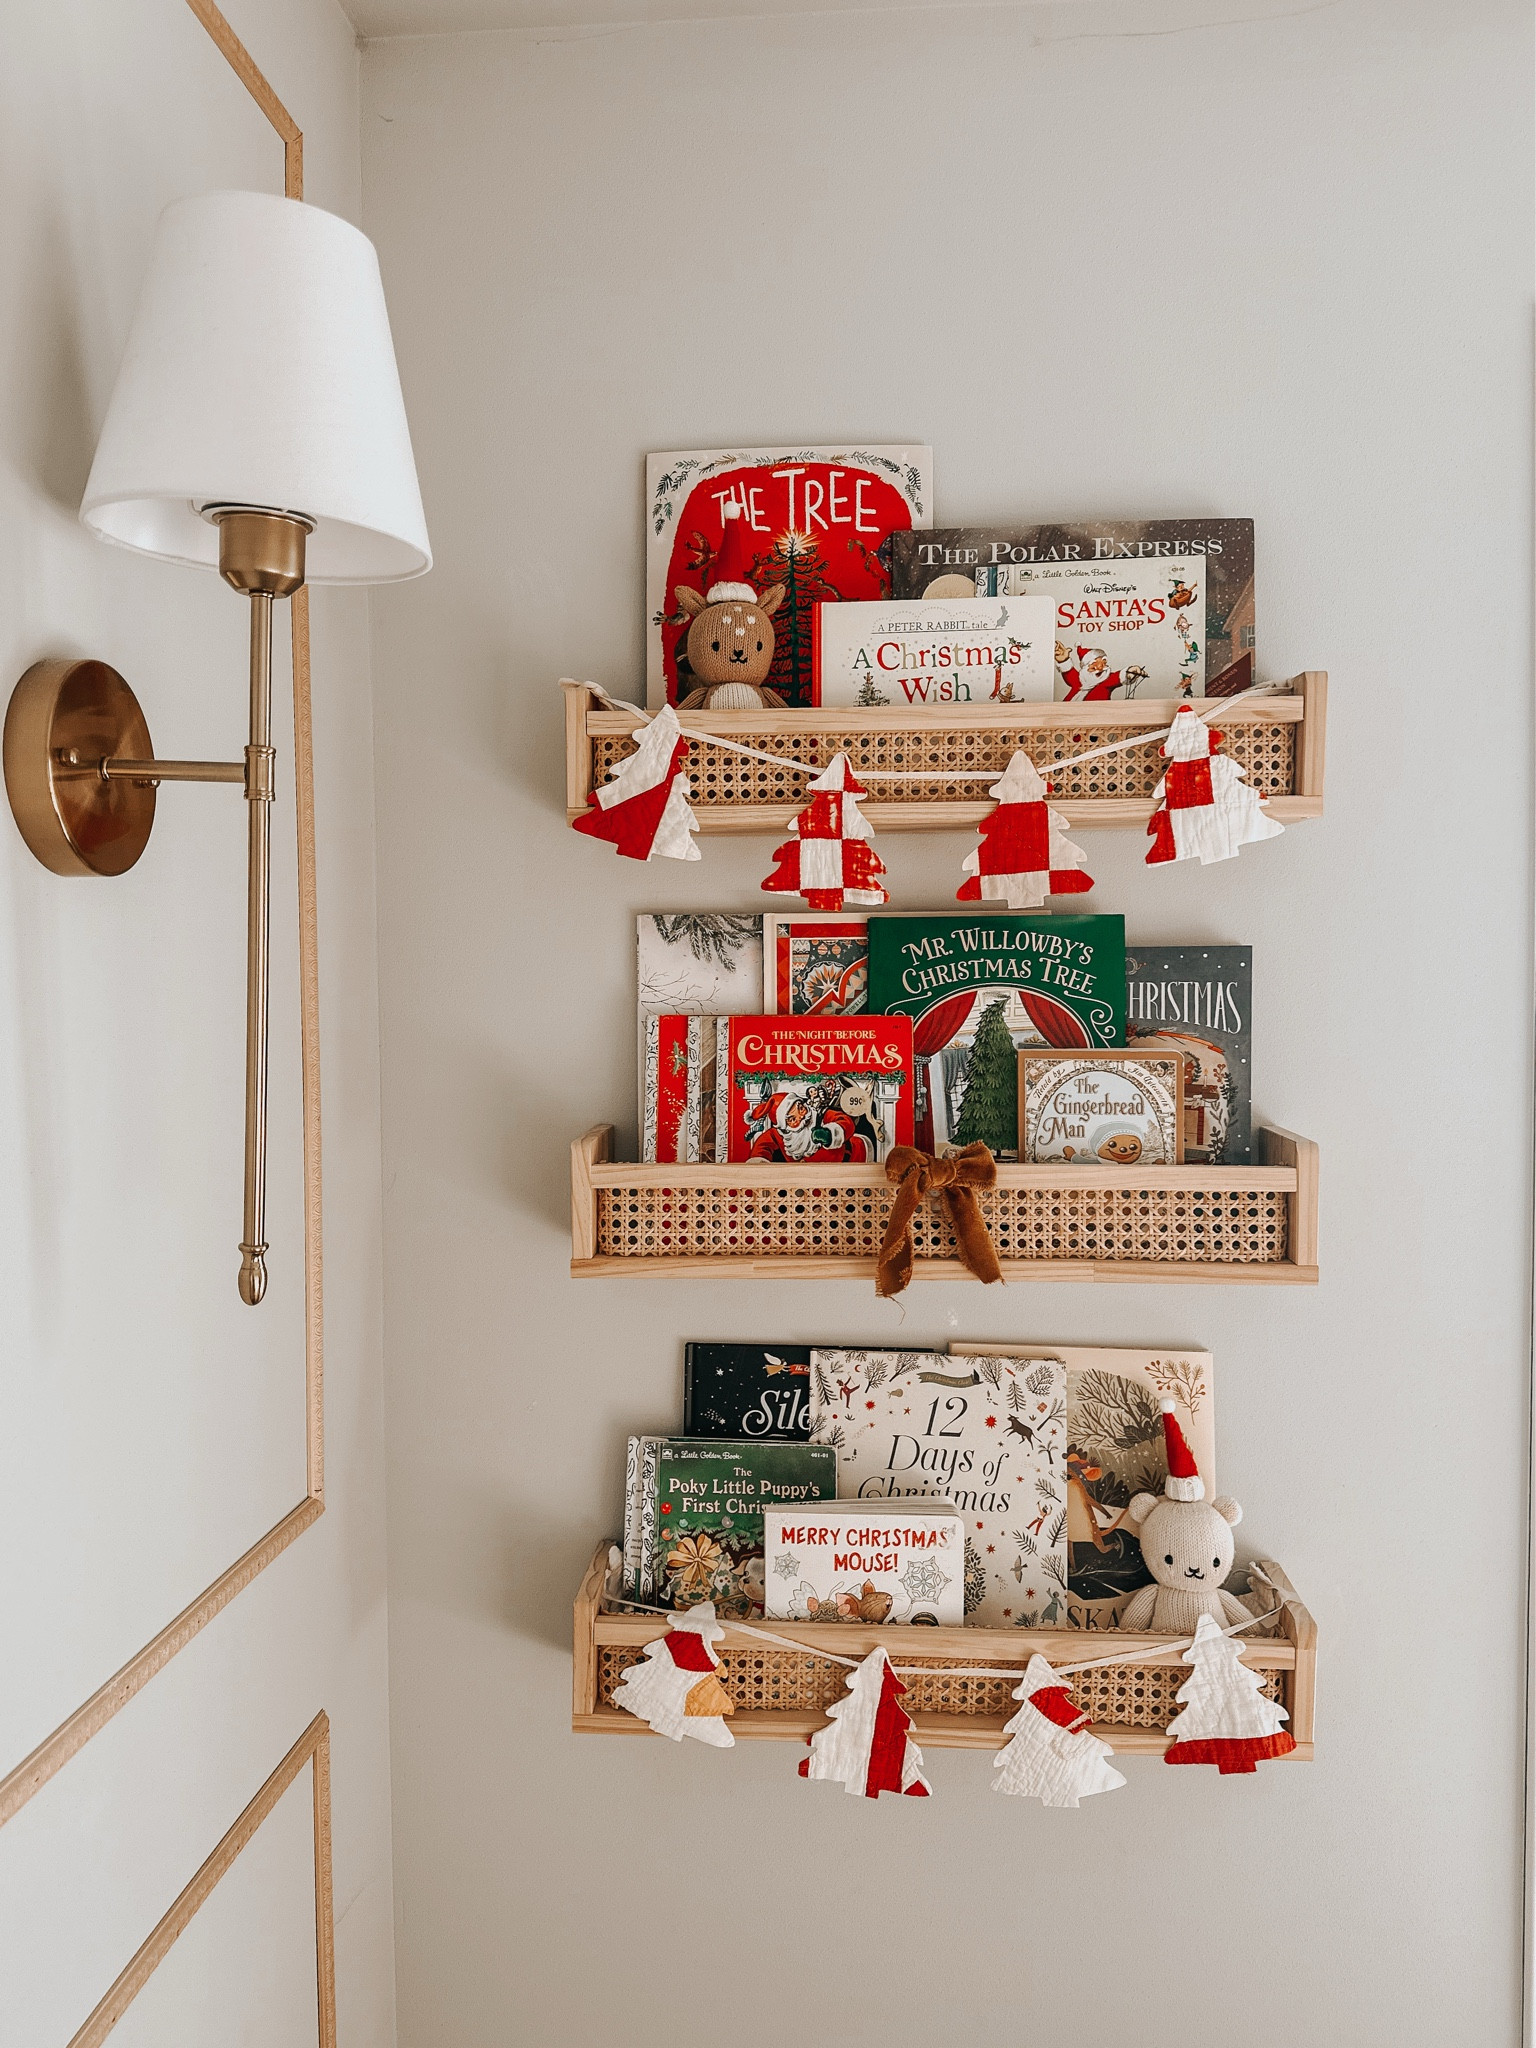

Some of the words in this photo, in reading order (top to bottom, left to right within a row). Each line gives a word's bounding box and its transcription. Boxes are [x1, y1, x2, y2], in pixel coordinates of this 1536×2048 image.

[711, 481, 772, 532] THE
[771, 467, 881, 536] TREE
[918, 543, 979, 566] THE
[987, 541, 1082, 564] POLAR
[1091, 537, 1224, 560] EXPRESS
[1042, 569, 1063, 579] Little
[1064, 569, 1091, 578] Golden
[1091, 568, 1112, 577] Book
[877, 624, 885, 632] A
[888, 621, 923, 632] PETER
[971, 620, 988, 630] tale
[1057, 598, 1166, 629] SANTA'S
[1077, 621, 1104, 633] TOY
[1108, 619, 1145, 632] SHOP
[851, 647, 874, 670] A
[876, 641, 1022, 671] Christmas
[897, 672, 973, 704] Wish
[901, 936, 954, 966] MR.
[950, 926, 1094, 966] WILLOWBY'S
[901, 958, 1032, 995] CHRISTMAS
[1038, 957, 1098, 995] TREE
[1125, 981, 1243, 1035] HRISTMAS
[771, 1030, 799, 1041] THE
[796, 1030, 833, 1041] NIGHT
[832, 1029, 877, 1041] BEFORE
[736, 1034, 904, 1073] CHRISTMAS
[1073, 1075, 1101, 1095] The
[1052, 1091, 1146, 1122] Gingerbread
[1037, 1116, 1087, 1146] Man
[741, 1388, 809, 1436] Sile
[921, 1396, 969, 1438] 12
[680, 1450, 699, 1459] Little
[699, 1450, 722, 1460] Golden
[884, 1434, 975, 1486] Days
[982, 1452, 1010, 1487] of
[733, 1467, 753, 1477] The
[668, 1478, 709, 1496] Poky
[712, 1478, 755, 1495] Little
[759, 1479, 821, 1499] Puppy's
[682, 1497, 721, 1513] First
[725, 1498, 769, 1515] Chris
[781, 1526, 841, 1546] MERRY
[846, 1526, 950, 1549] CHRISTMAS
[833, 1551, 899, 1573] MOUSE!
[1067, 1605, 1126, 1630] SKA
